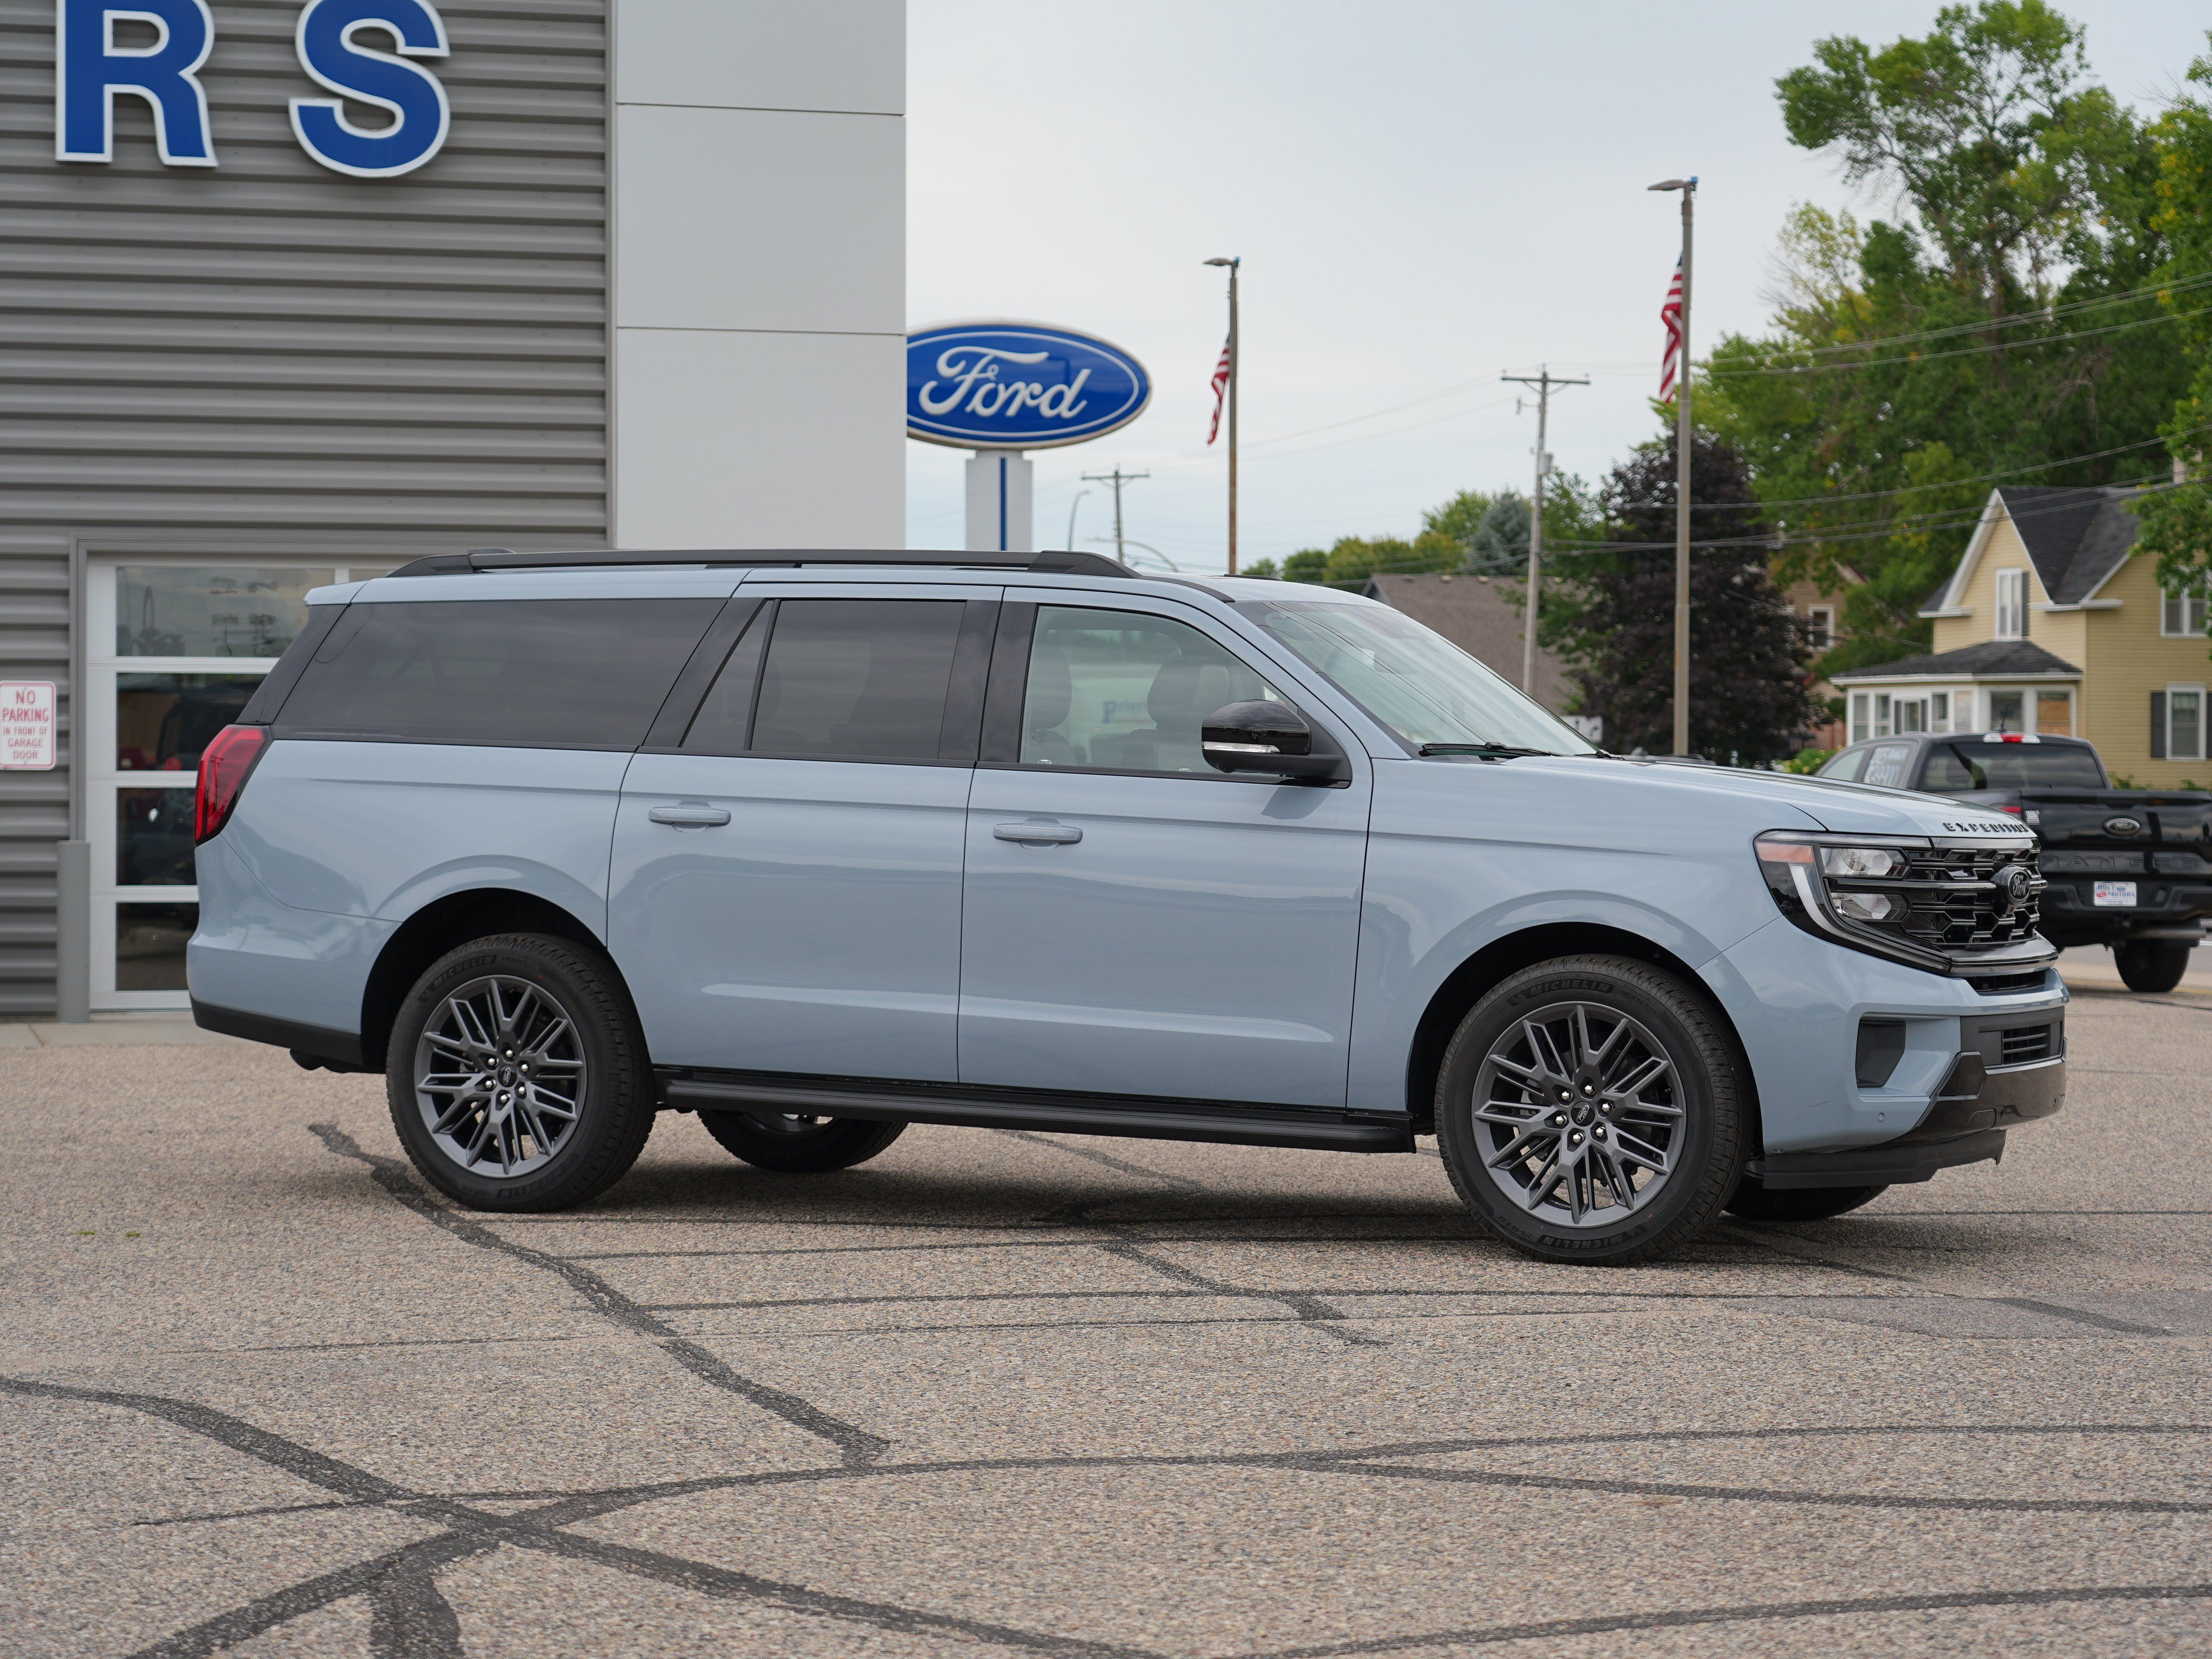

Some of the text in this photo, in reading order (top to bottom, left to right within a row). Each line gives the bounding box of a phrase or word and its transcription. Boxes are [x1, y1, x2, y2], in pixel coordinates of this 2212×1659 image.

[919, 346, 1092, 419] Ford
[16, 689, 36, 704] NO
[3, 707, 49, 722] PARKING
[3, 726, 49, 735] IN FRONT OF
[8, 737, 44, 747] GARAGE
[13, 750, 38, 759] DOOR
[2013, 874, 2027, 896] Ford
[1530, 979, 1610, 996] MICHELIN
[1512, 1225, 1533, 1238] 275/50
[1542, 1234, 1622, 1250] MICHELIN
